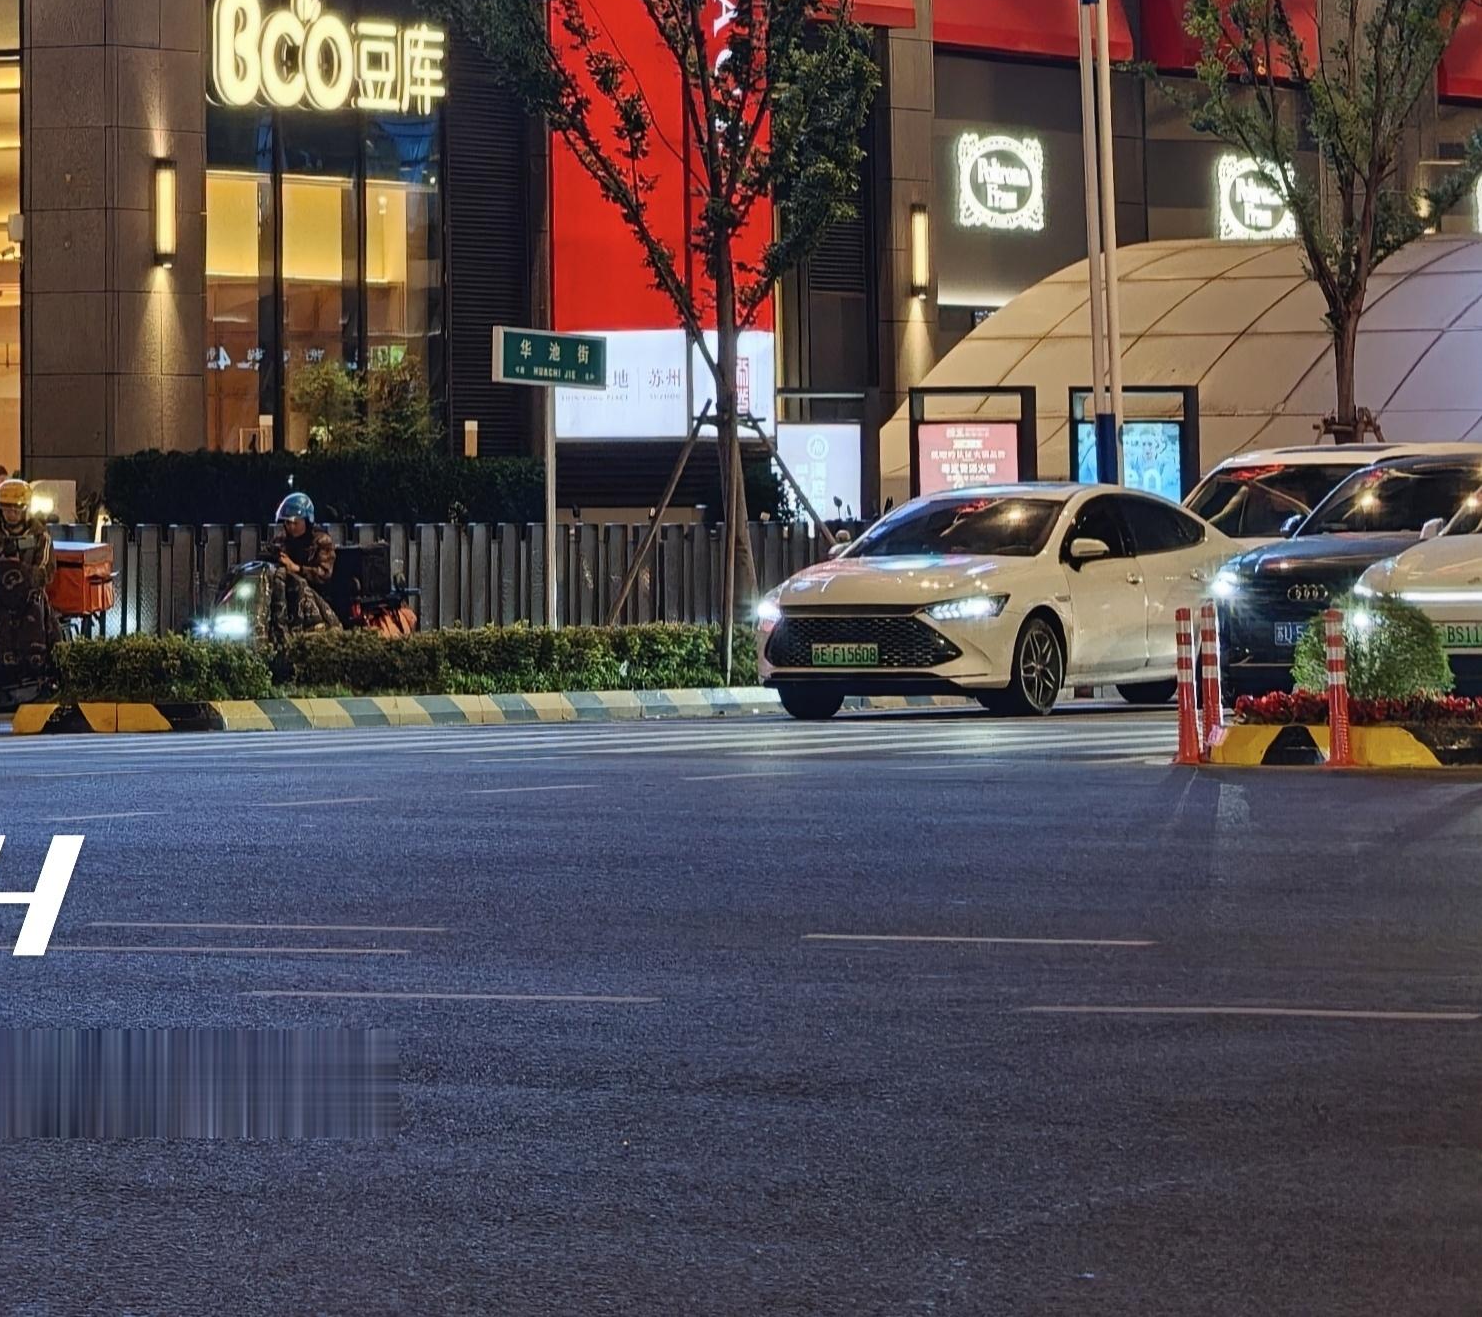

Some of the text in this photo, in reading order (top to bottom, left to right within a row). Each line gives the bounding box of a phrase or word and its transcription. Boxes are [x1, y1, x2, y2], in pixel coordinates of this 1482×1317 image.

[520, 338, 590, 365] 华池街
[564, 369, 576, 381] JIE
[649, 367, 681, 388] 苏州
